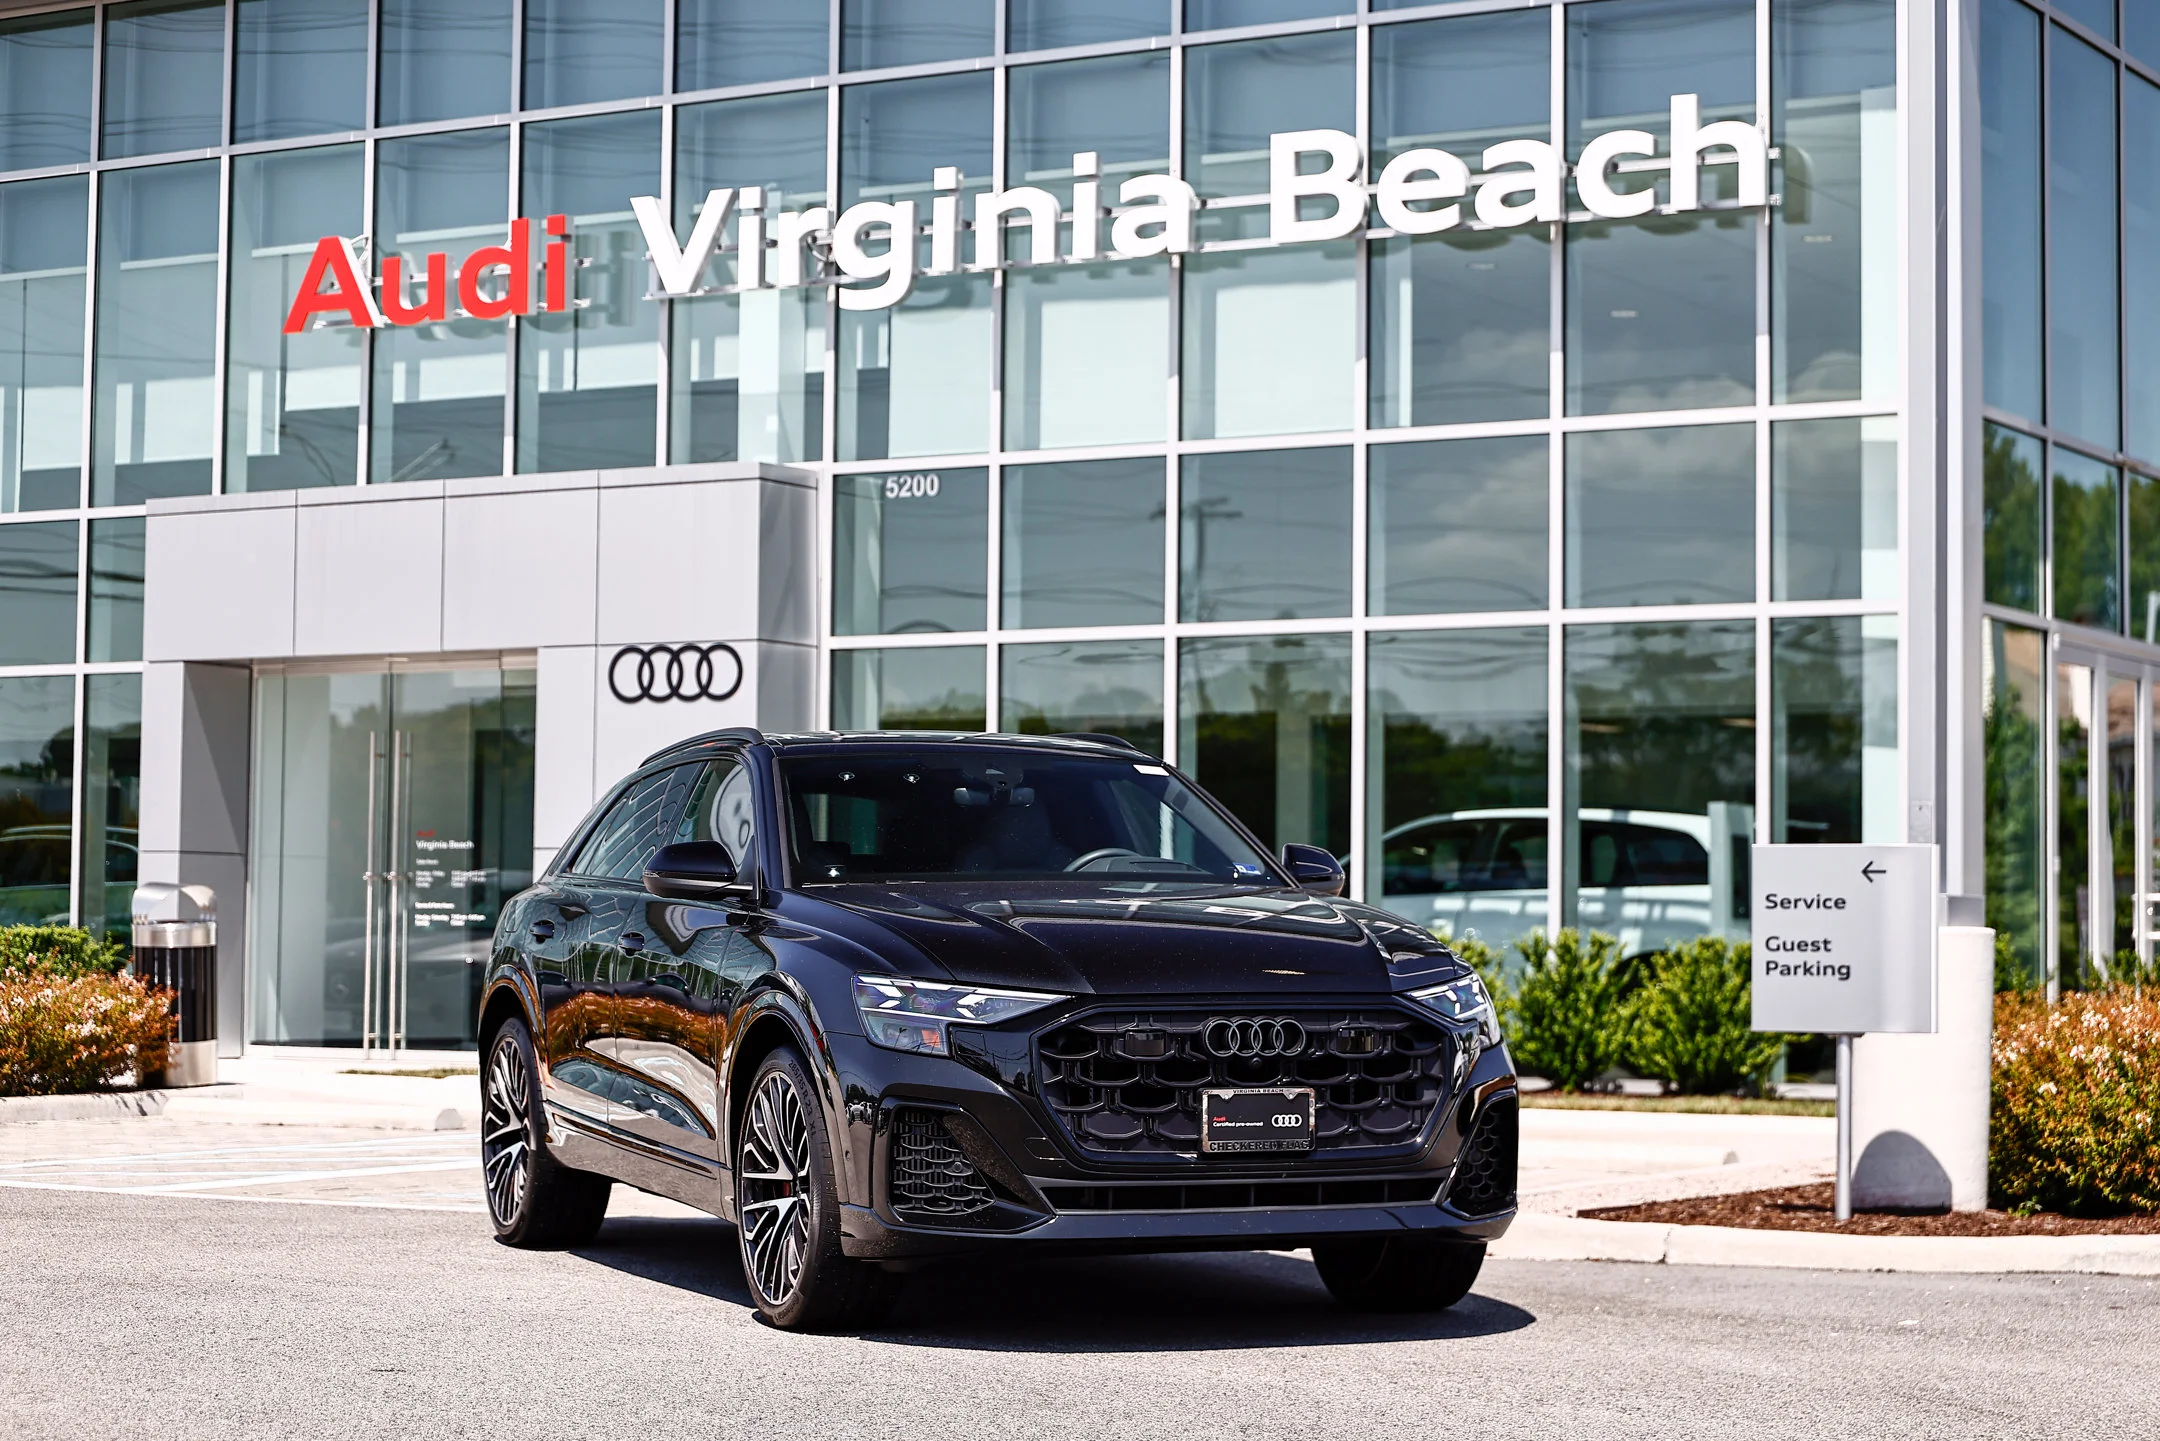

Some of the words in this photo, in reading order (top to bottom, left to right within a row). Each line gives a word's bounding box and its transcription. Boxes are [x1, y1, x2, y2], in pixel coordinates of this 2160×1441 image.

[283, 213, 570, 334] Audi
[630, 151, 1196, 310] Virginia
[1269, 93, 1770, 244] Beach
[885, 473, 940, 499] 5200
[416, 840, 448, 851] Virginia
[1765, 893, 1847, 910] Service
[1765, 936, 1832, 952] Guest
[1765, 960, 1852, 981] Parking
[1209, 1141, 1278, 1151] CHECKERED
[1280, 1140, 1309, 1150] FLAG
